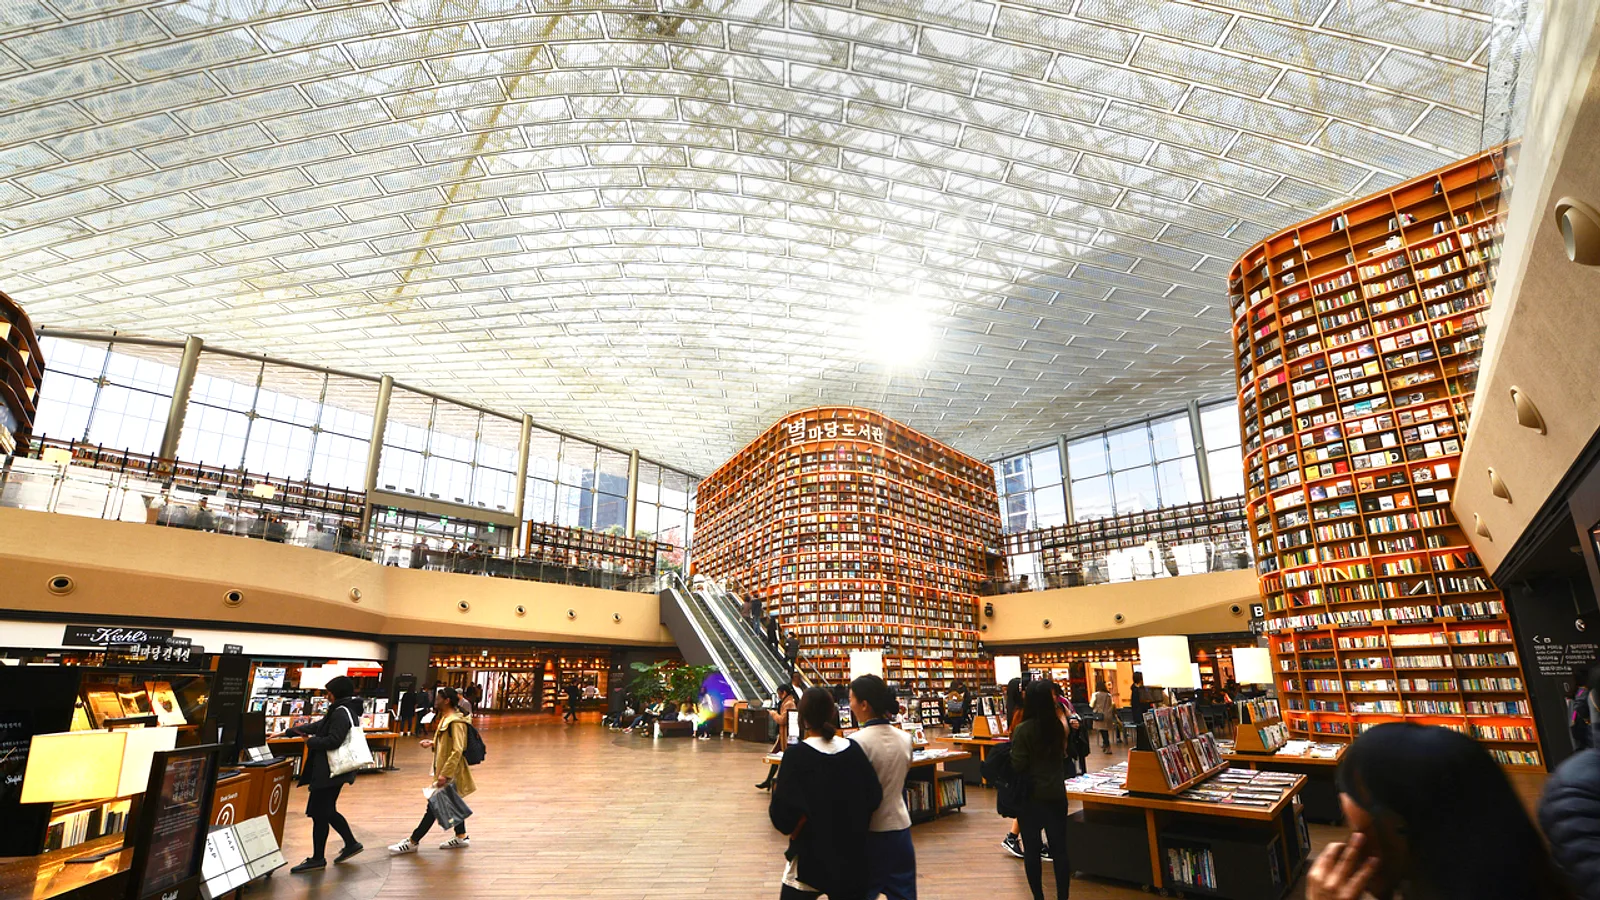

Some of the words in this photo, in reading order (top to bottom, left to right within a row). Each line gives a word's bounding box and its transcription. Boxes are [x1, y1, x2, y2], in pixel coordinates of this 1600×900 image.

[1254, 606, 1264, 617] B
[90, 627, 148, 643] Kiehl's
[225, 832, 235, 851] MAP
